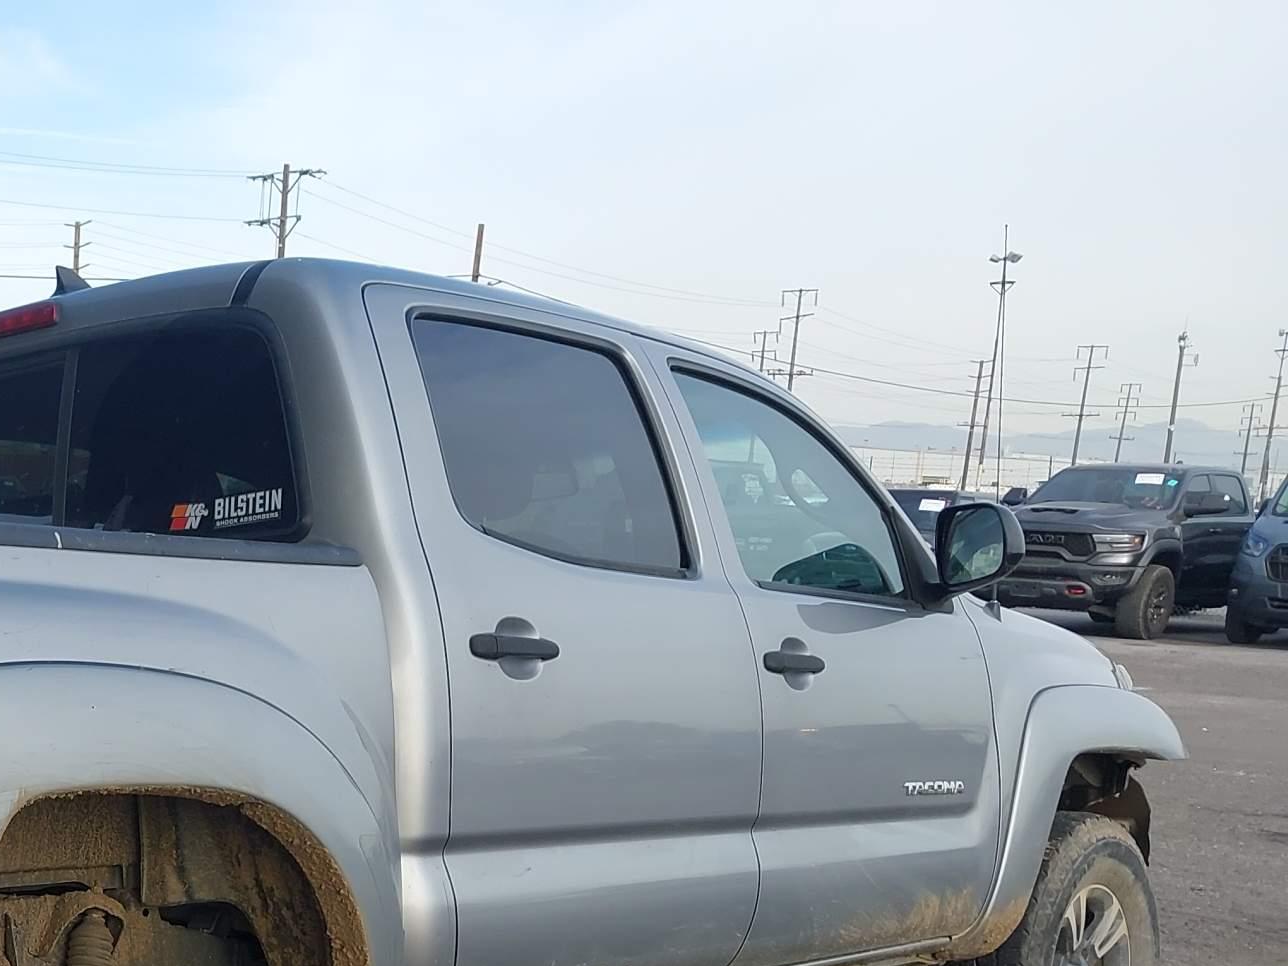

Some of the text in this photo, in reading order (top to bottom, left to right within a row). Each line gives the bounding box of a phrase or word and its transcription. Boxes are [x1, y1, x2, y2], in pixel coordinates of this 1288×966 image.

[214, 487, 283, 520] BILSTEIN
[216, 518, 238, 526] SHOCK
[903, 780, 965, 795] TACOMA
